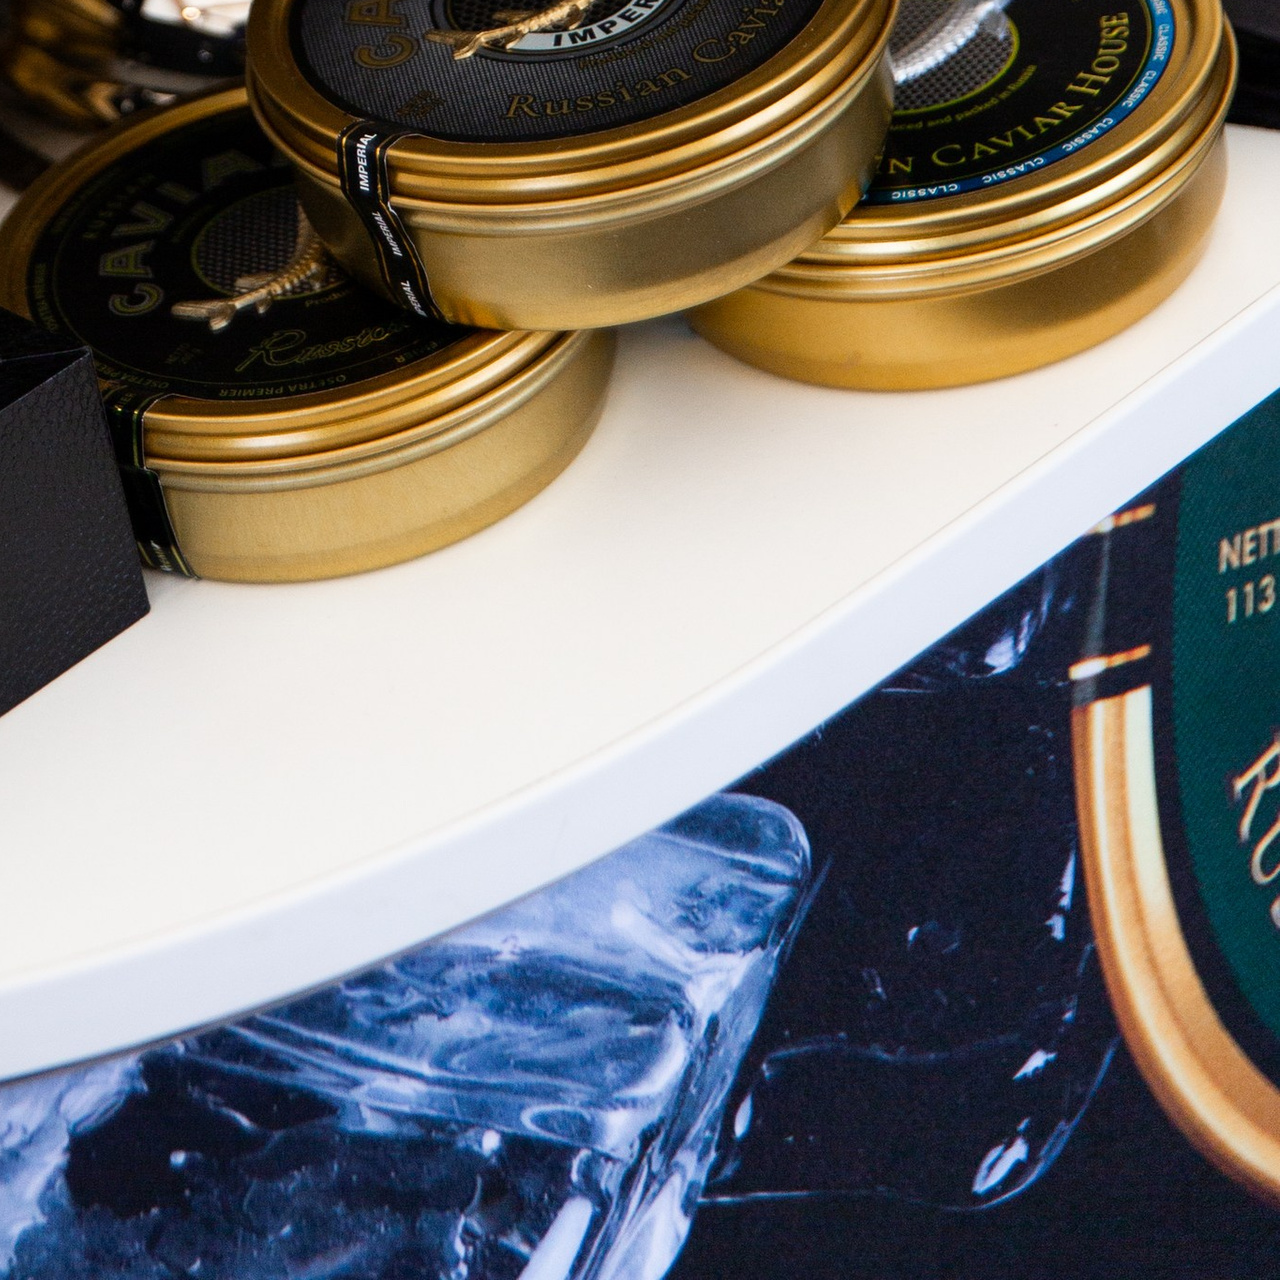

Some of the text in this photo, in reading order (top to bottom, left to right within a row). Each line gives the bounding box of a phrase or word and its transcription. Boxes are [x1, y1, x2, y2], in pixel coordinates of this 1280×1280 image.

[1152, 24, 1170, 61] CLASSIC
[503, 65, 694, 120] Russian
[931, 11, 1130, 167] CAVIAR HOUSE
[1122, 70, 1157, 108] CLASSIC
[1062, 117, 1114, 152] CLASSIC
[356, 133, 377, 192] IMPERIAL
[982, 156, 1045, 184] CLASSIC
[891, 183, 959, 200] CLASSIC
[98, 148, 267, 316] CAVIA
[372, 211, 403, 258] IMPERIAL
[219, 386, 284, 398] PREMIER
[1218, 516, 1280, 575] NETT
[1225, 573, 1276, 625] 113
